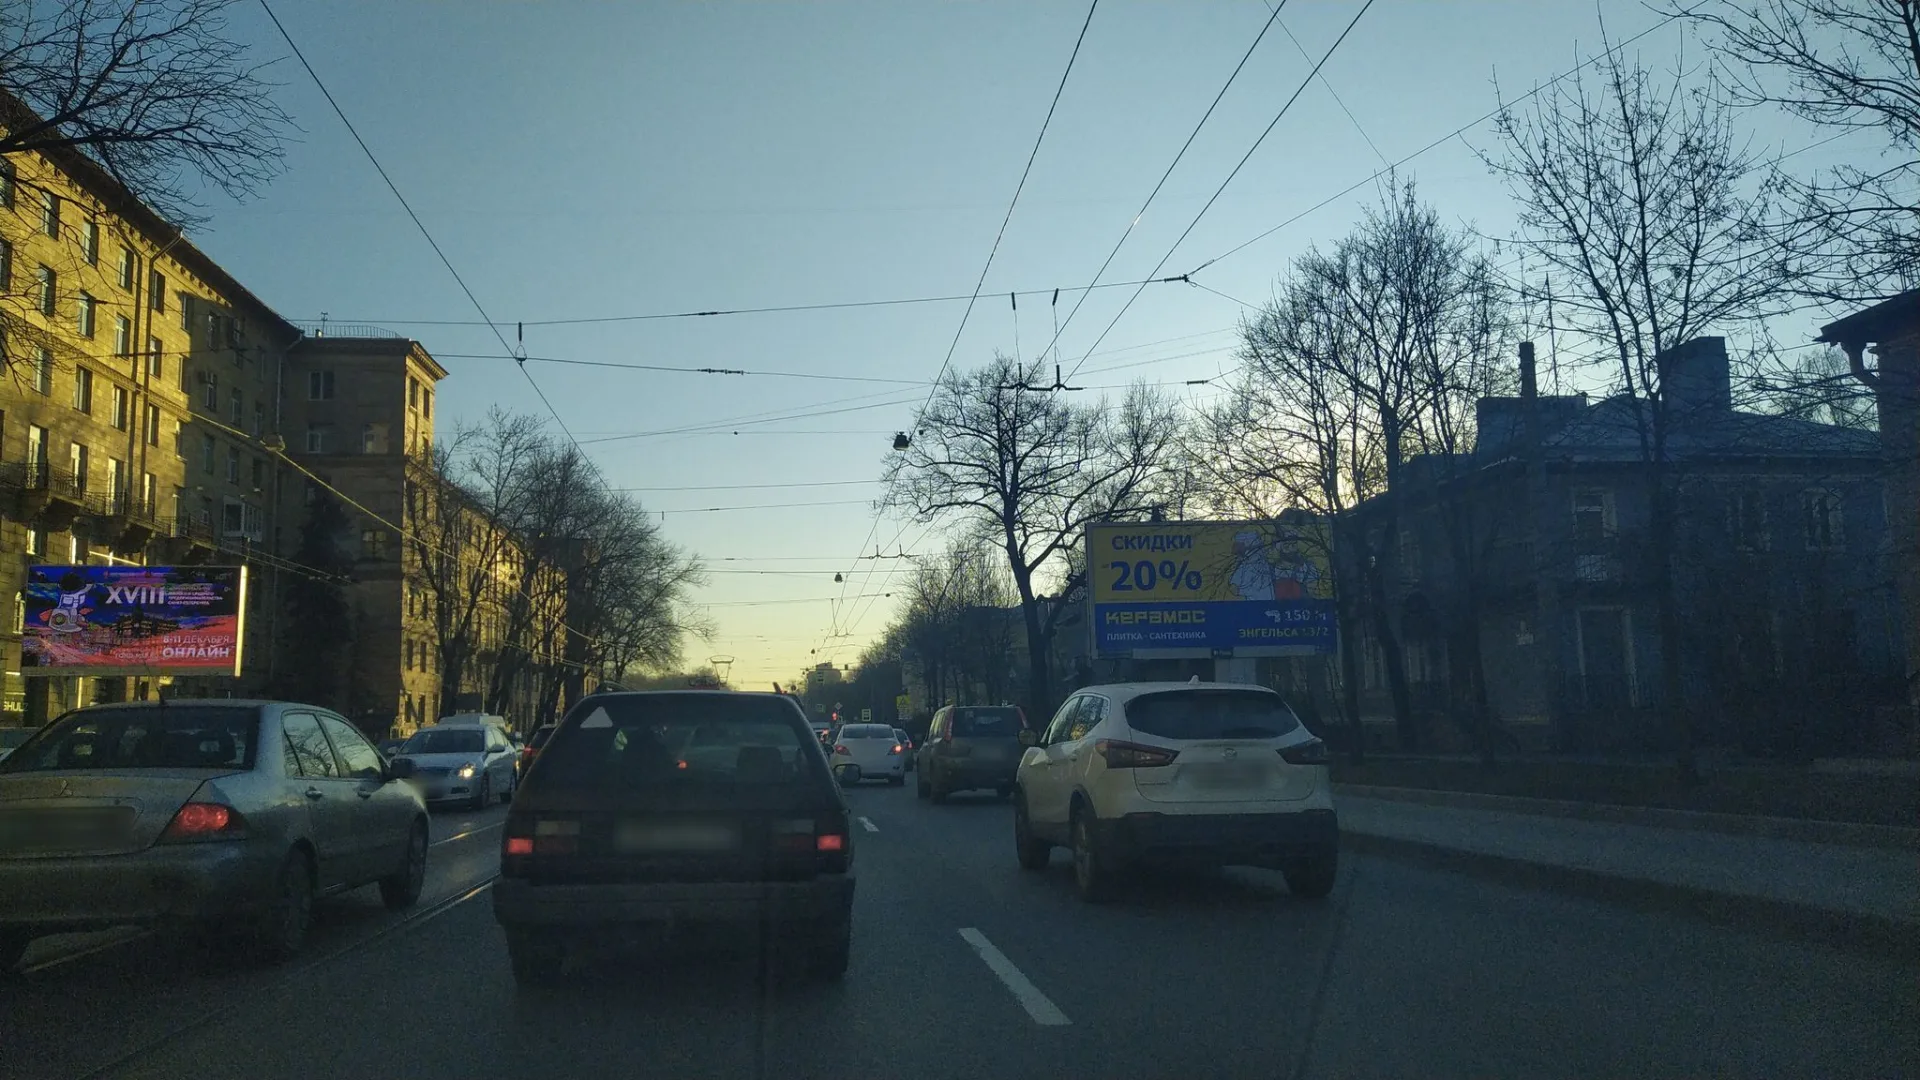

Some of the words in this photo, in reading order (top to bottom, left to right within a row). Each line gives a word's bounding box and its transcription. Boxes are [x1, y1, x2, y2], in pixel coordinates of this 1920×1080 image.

[1112, 535, 1192, 552] СКИДКИ
[1111, 560, 1203, 591] 20%
[105, 586, 166, 605] XVIII
[1284, 609, 1311, 621] 150
[1106, 632, 1143, 641] ПЛИТКА
[1149, 631, 1207, 640] САНТЕХНИКА
[1238, 627, 1299, 638] ЭНГЕЛЬСА
[182, 635, 230, 645] ДЕКАБРЯ
[162, 644, 230, 659] ОНЛАЙН
